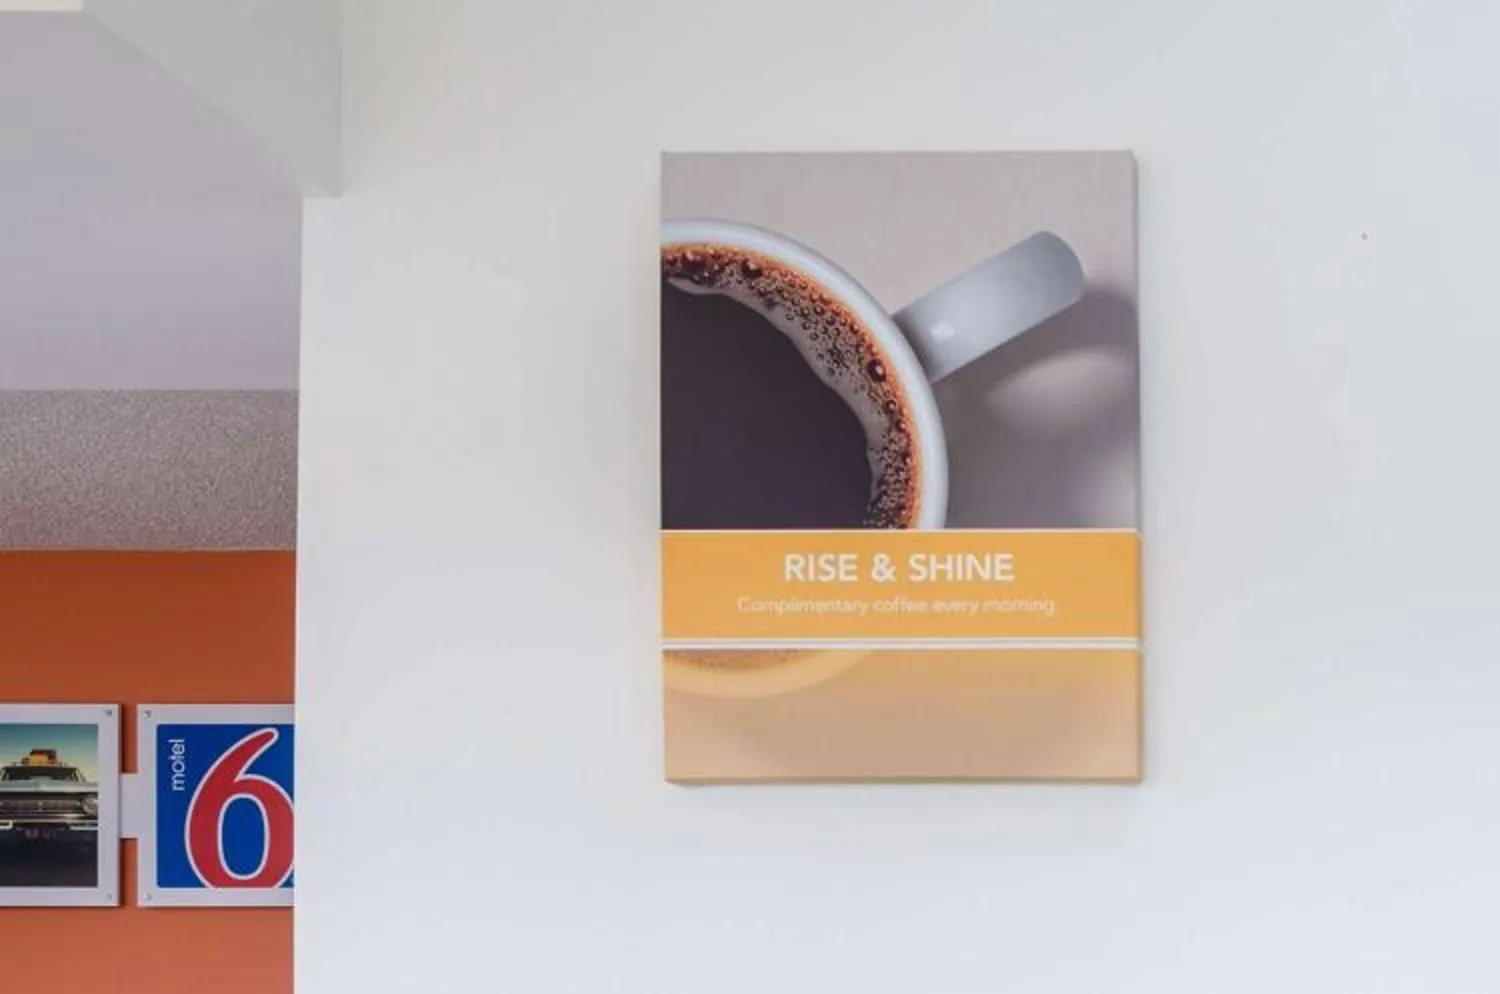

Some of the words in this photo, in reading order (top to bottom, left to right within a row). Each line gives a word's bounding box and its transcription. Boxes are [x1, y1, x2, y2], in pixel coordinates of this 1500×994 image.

[784, 553, 858, 581] RISE
[871, 553, 896, 582] &
[909, 553, 1014, 582] SHINE
[737, 596, 869, 617] Complimentary
[872, 594, 927, 614] coffee
[931, 599, 979, 616] every
[167, 738, 185, 791] motel
[184, 727, 294, 889] 6
